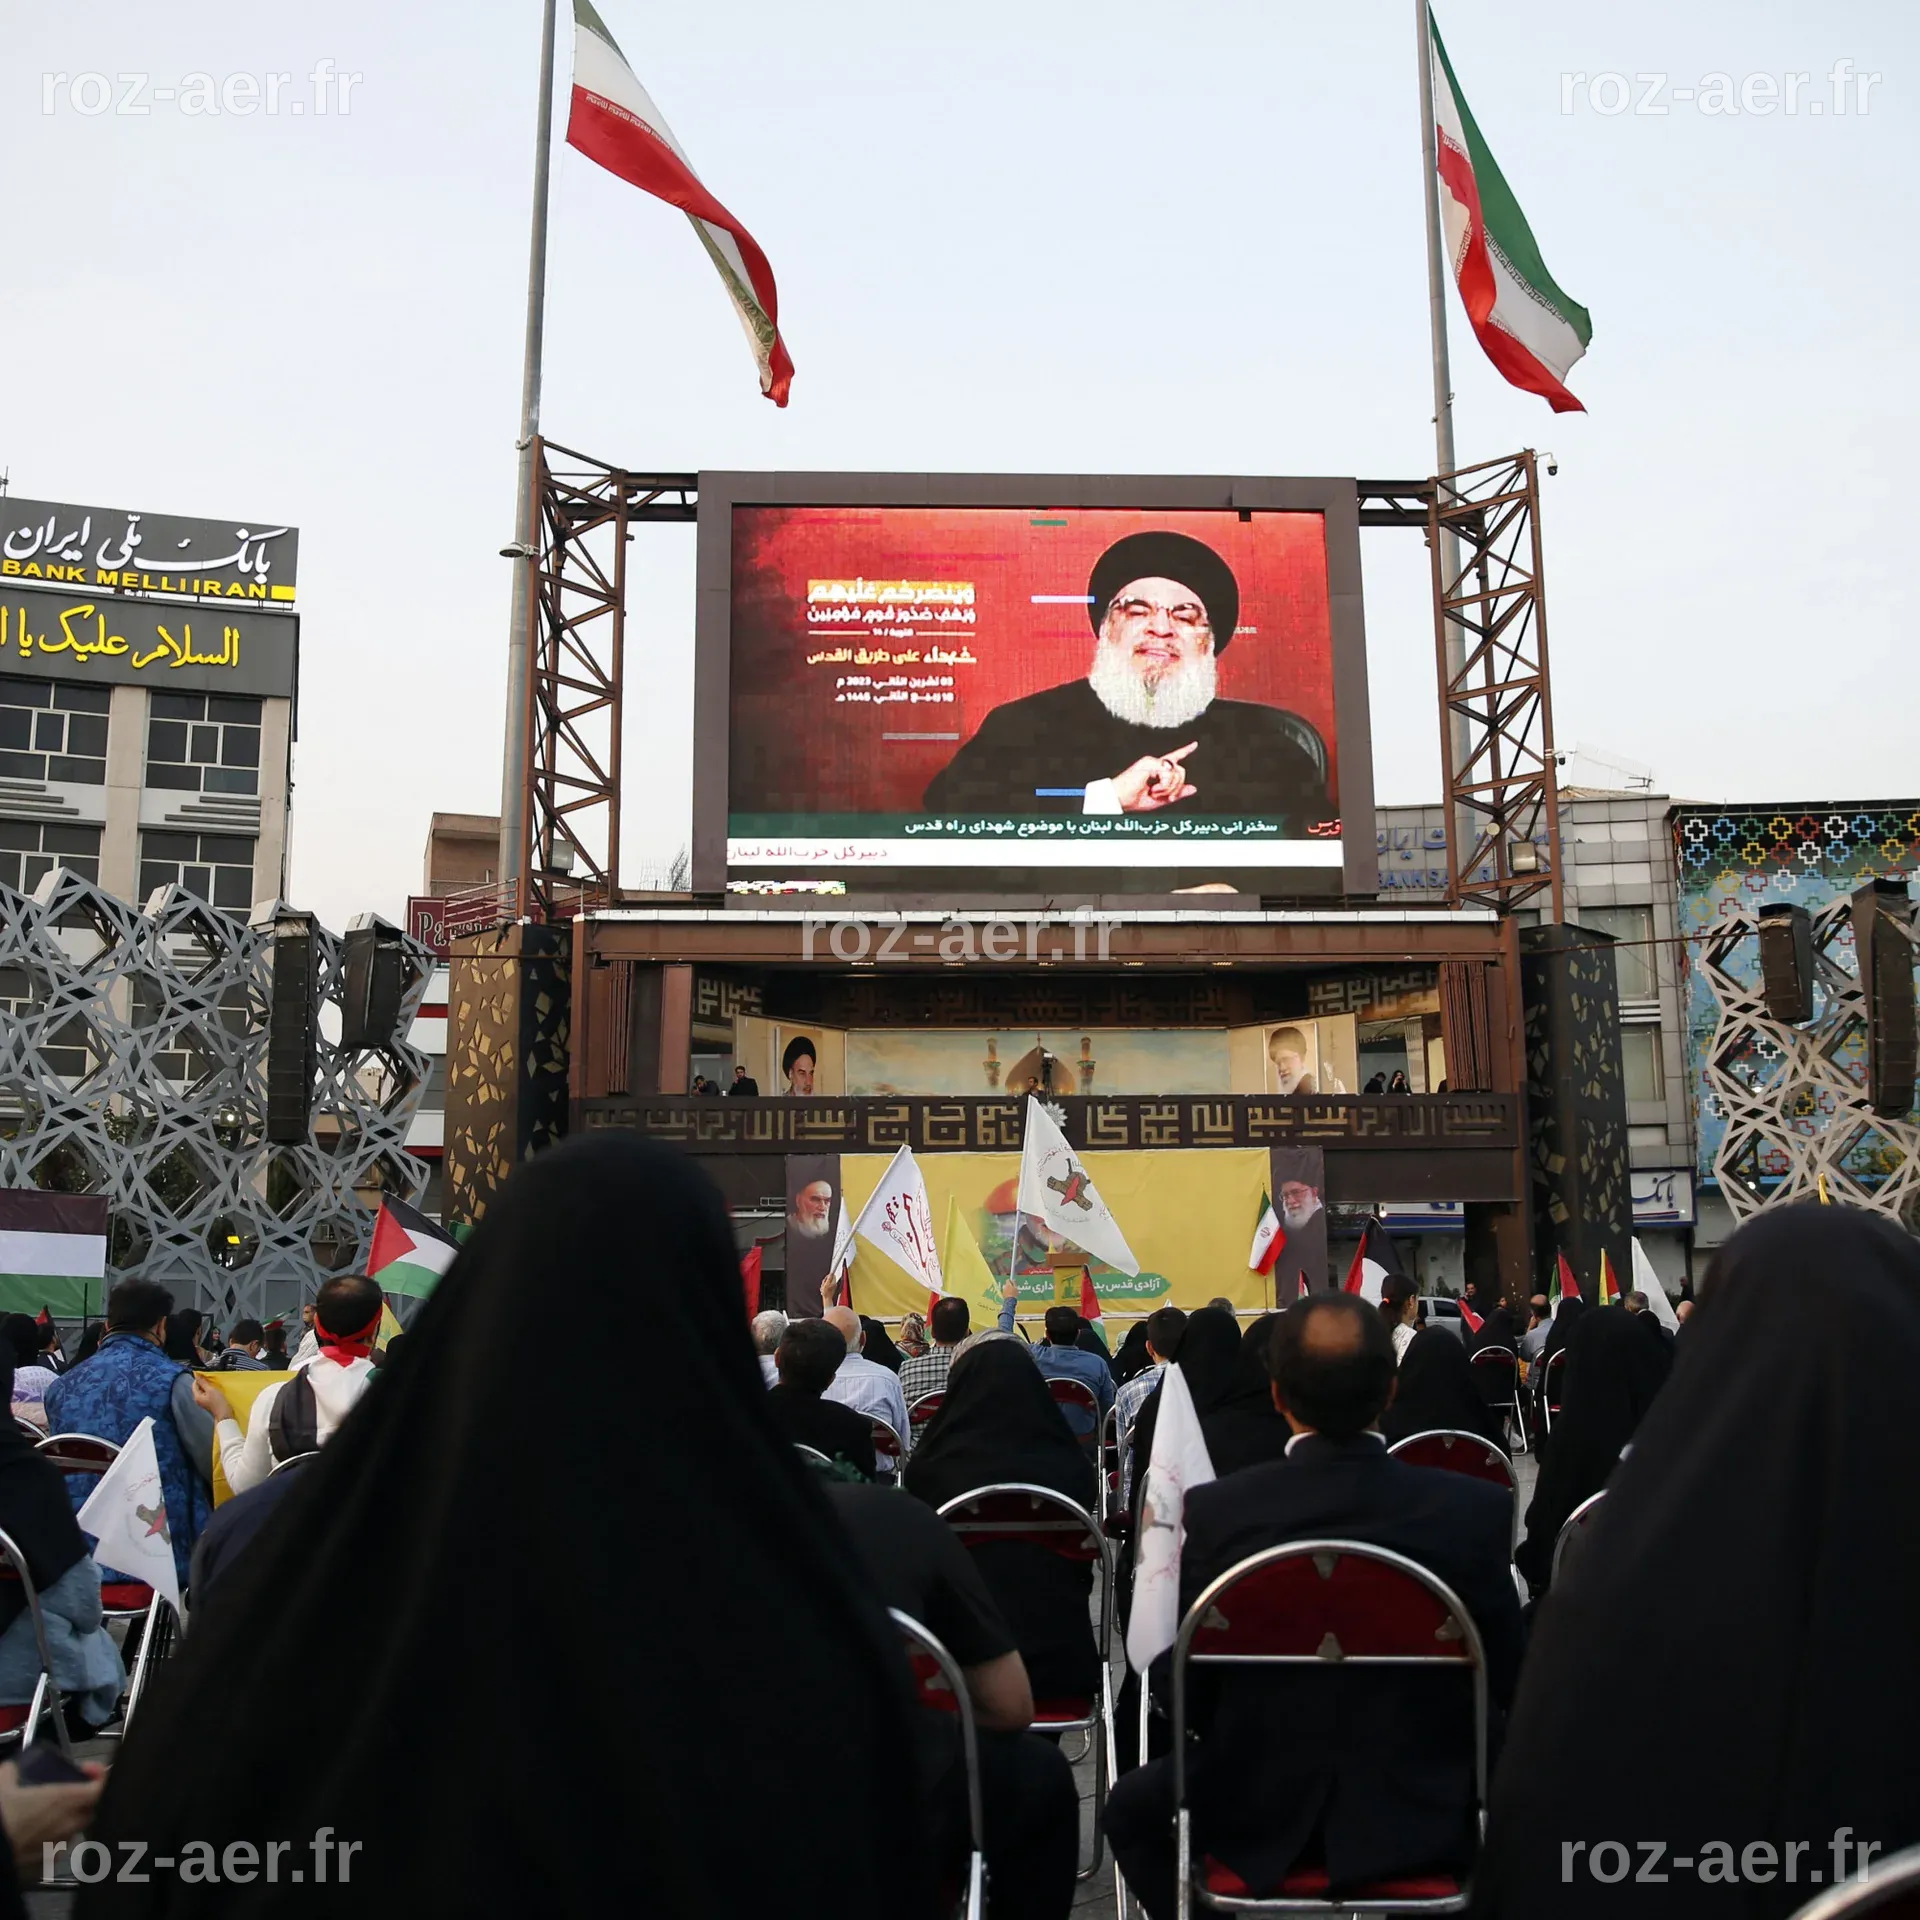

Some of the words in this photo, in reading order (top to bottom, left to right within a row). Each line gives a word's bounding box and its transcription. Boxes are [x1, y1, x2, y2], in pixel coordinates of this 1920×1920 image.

[3, 516, 91, 561] ایران
[2, 559, 87, 582] BANK
[97, 571, 186, 592] MELLI
[193, 578, 266, 599] IRAN
[132, 624, 240, 668] السلام
[905, 819, 943, 835] قدس
[946, 819, 965, 834] راه
[969, 819, 1015, 835] شهدای
[1017, 820, 1064, 838] موضوع
[1066, 820, 1075, 835] با
[1079, 820, 1111, 835] لبنان
[1221, 819, 1278, 835] سخنرانی
[1106, 1278, 1133, 1293] قدس
[1135, 1277, 1161, 1293] آزادی
